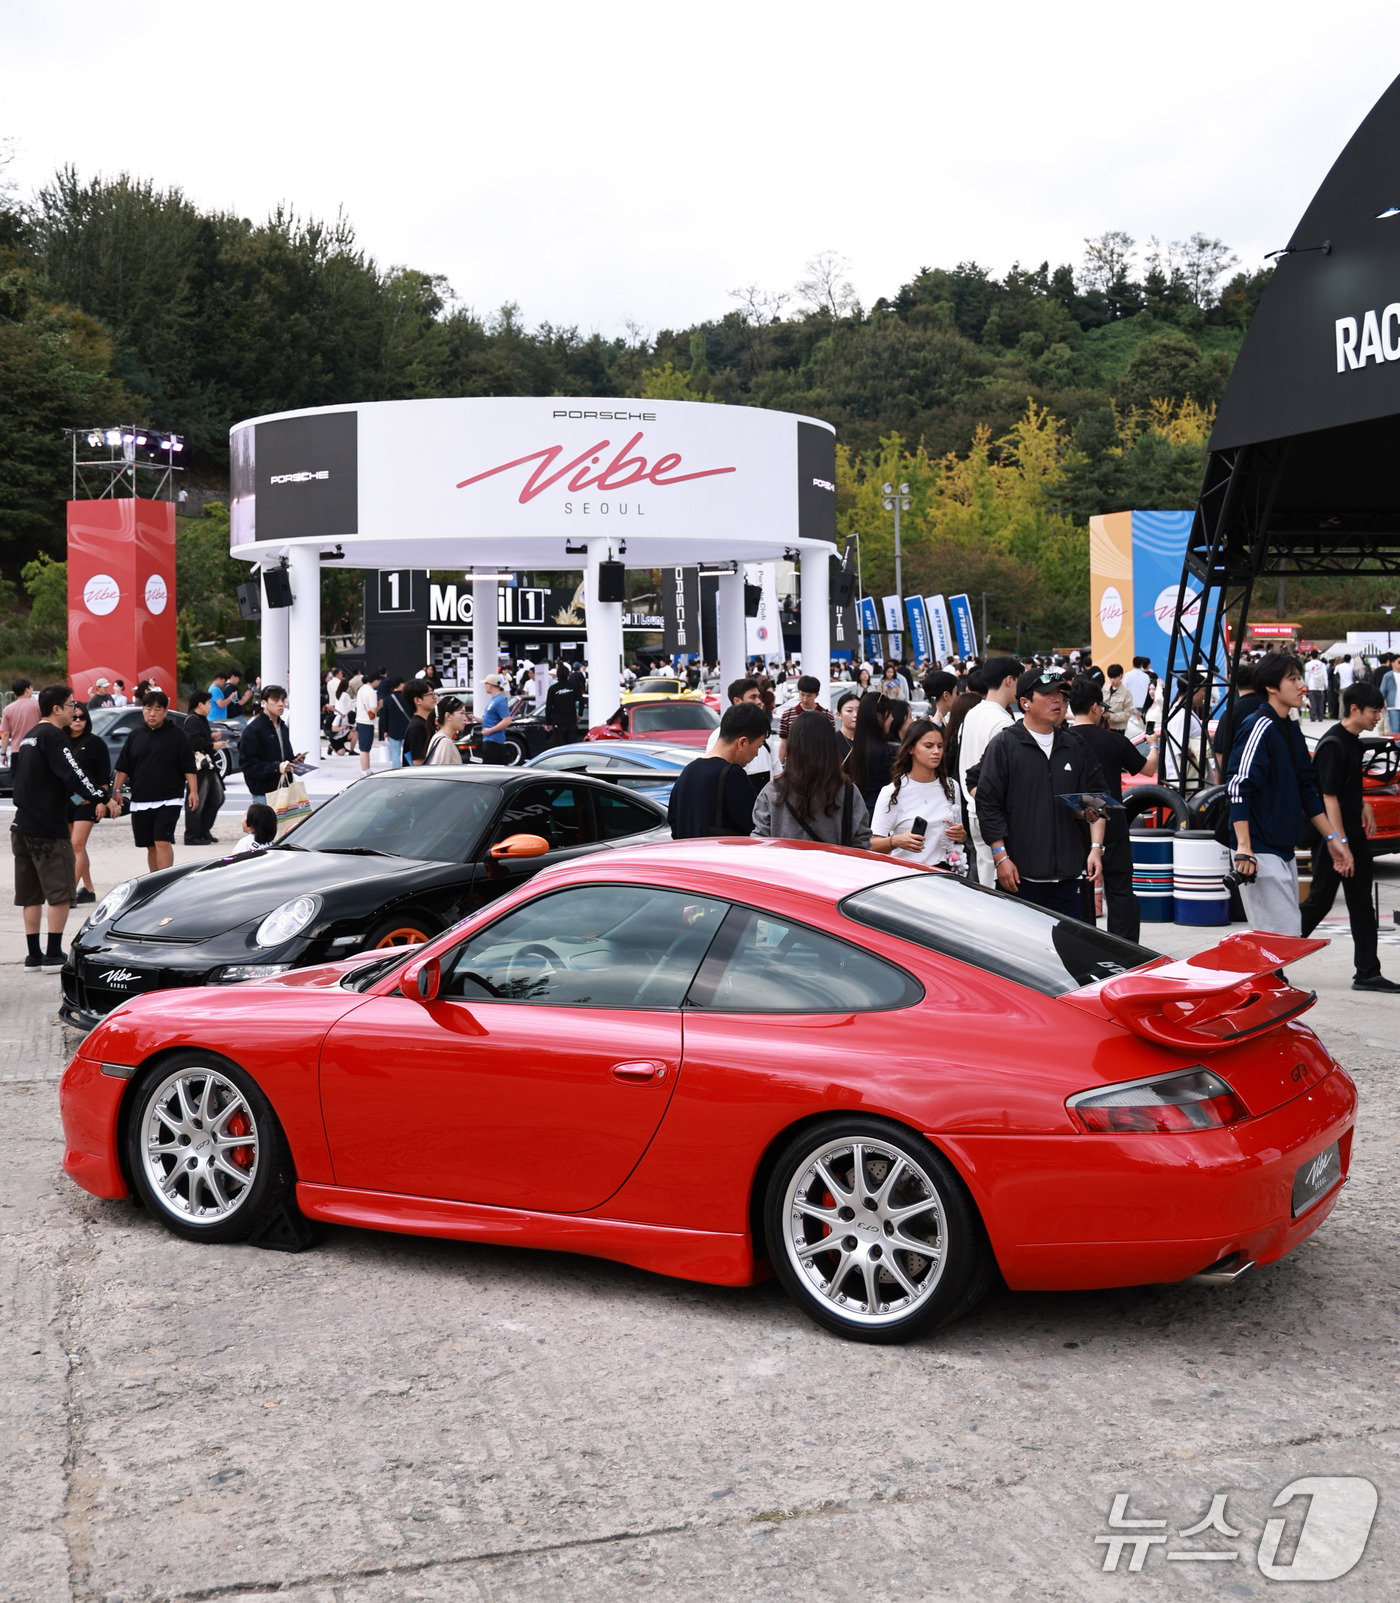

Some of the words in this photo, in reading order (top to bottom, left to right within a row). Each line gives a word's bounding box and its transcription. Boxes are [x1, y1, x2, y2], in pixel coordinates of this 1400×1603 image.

[553, 411, 657, 421] PORSCHE
[456, 431, 737, 504] Vibe
[270, 470, 330, 485] PORSCHE
[564, 502, 645, 516] SEOUL
[430, 584, 513, 623] Moil
[675, 567, 686, 646] ORSCHE
[913, 608, 925, 652] MICHELIN
[934, 608, 946, 652] MICHELIN
[957, 607, 970, 652] MICHELIN
[98, 968, 142, 983] Vibe
[1291, 1063, 1308, 1082] GT3
[196, 1140, 211, 1150] GT3
[857, 1222, 880, 1232] GT3
